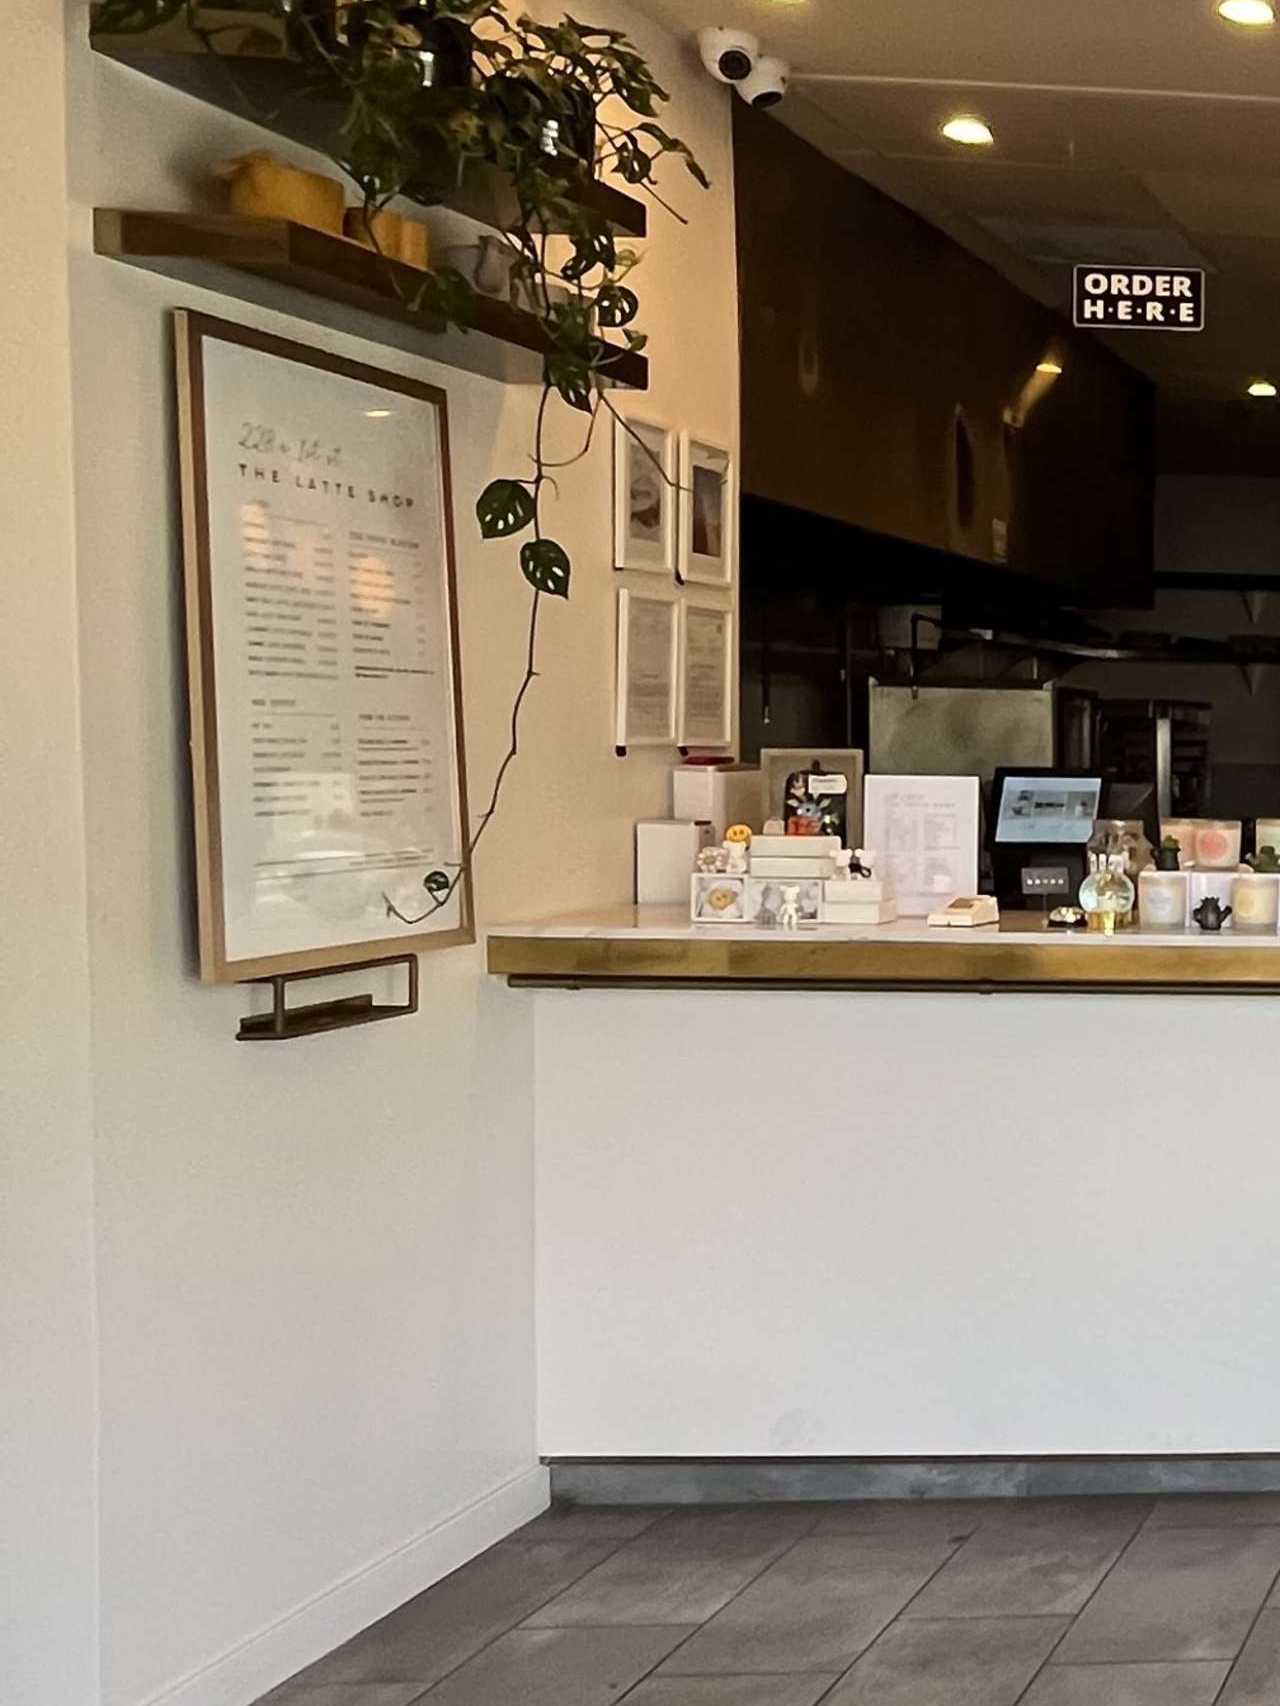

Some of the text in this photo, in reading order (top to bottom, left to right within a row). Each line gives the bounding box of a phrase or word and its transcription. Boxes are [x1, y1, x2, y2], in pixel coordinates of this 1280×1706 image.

[1084, 273, 1193, 297] ORDER
[238, 463, 415, 508] THE LATTE SHOP
